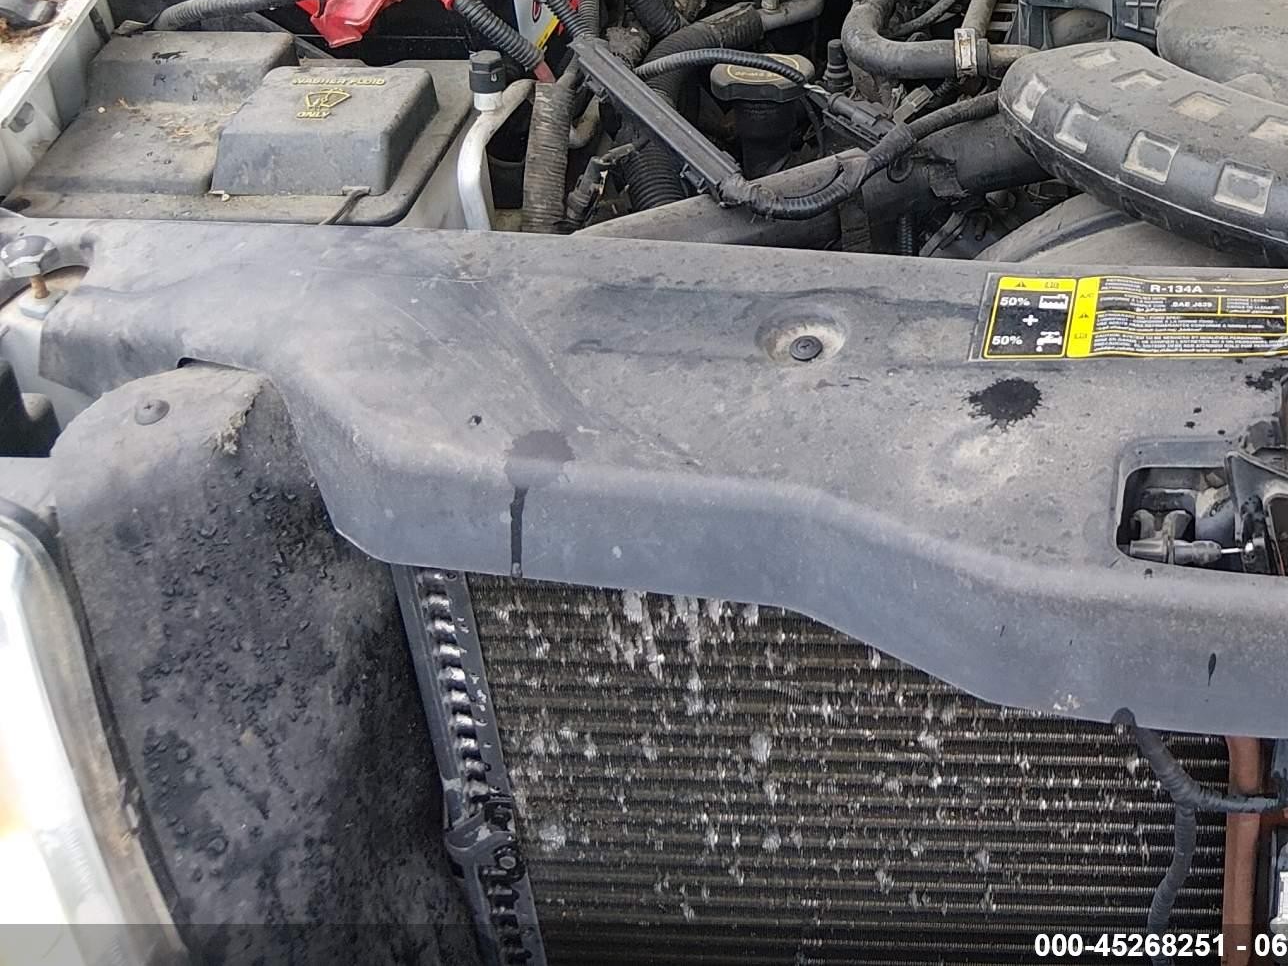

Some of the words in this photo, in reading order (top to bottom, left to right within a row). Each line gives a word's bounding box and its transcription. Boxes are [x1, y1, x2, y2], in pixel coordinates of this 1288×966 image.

[349, 78, 386, 86] FLUID
[296, 111, 331, 119] ONLY
[1149, 284, 1203, 294] R-134A
[999, 296, 1031, 307] 50%
[991, 335, 1024, 346] 50%
